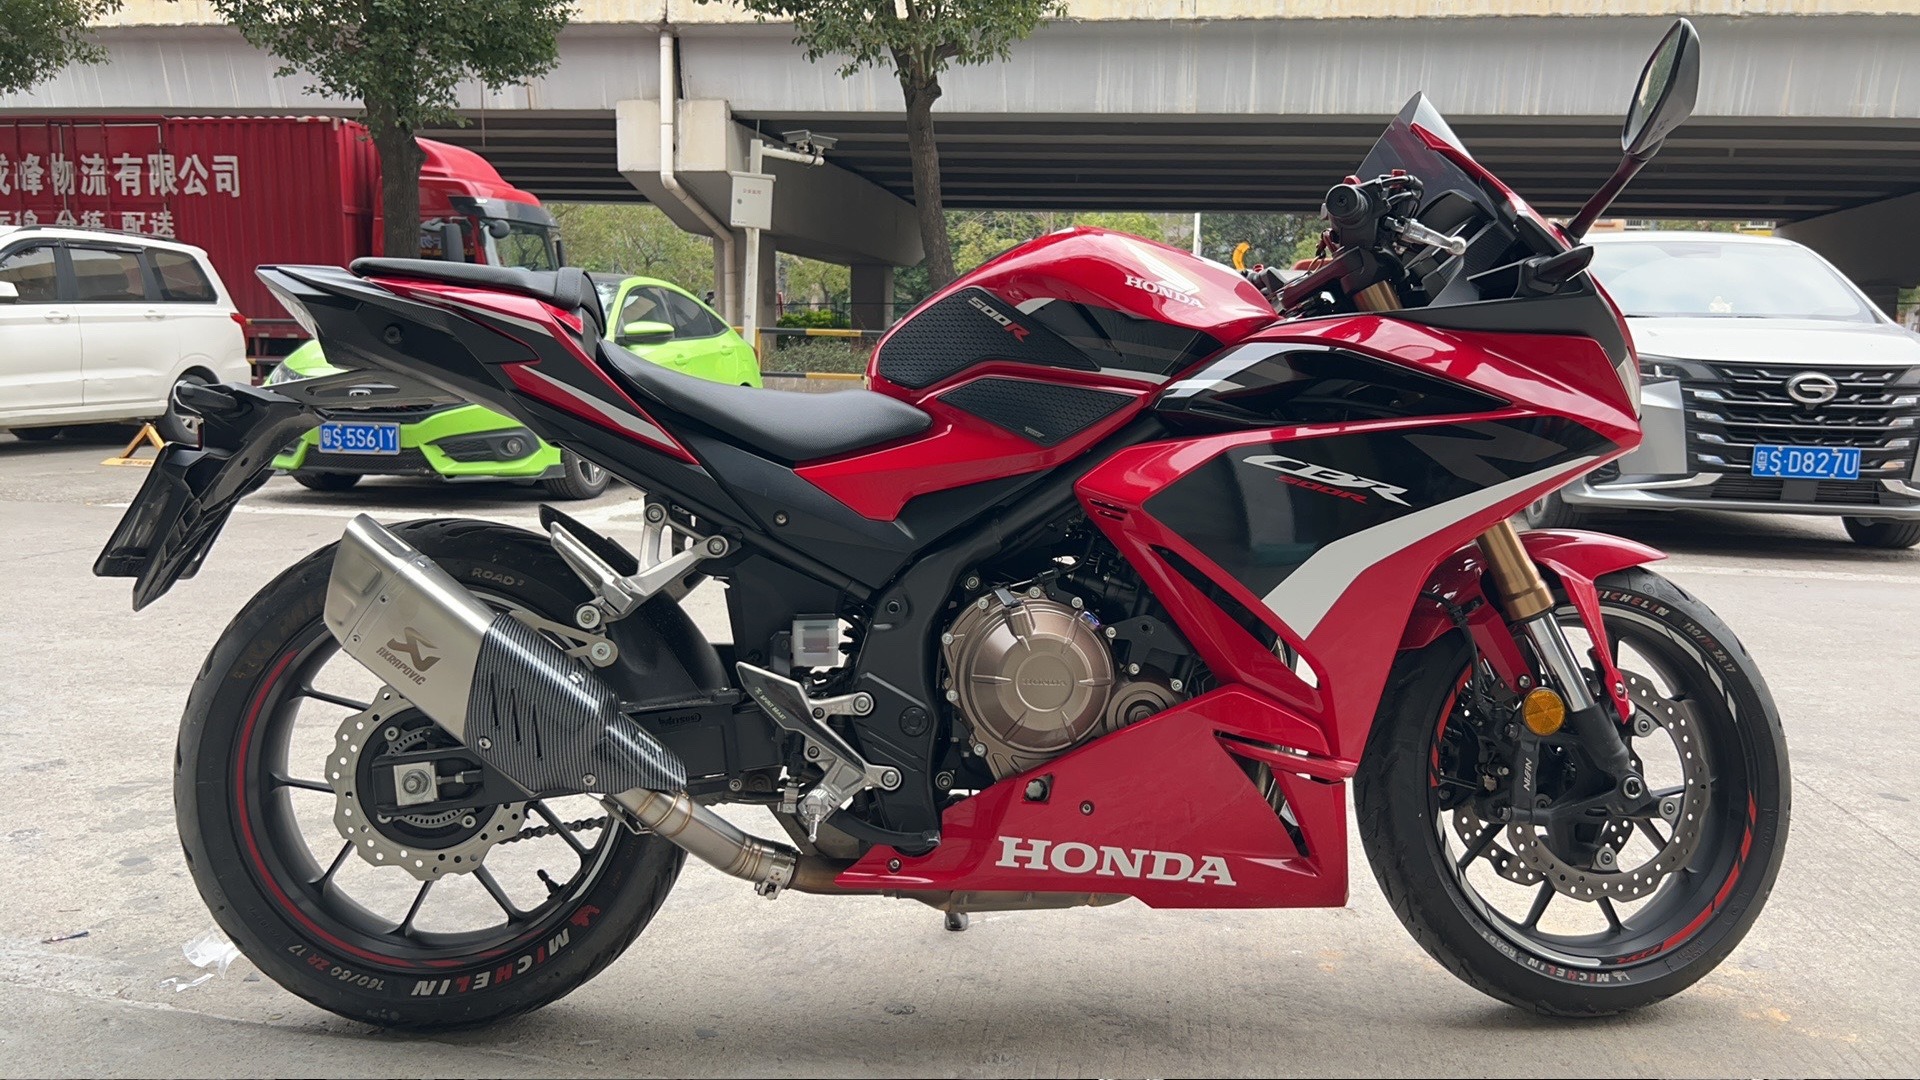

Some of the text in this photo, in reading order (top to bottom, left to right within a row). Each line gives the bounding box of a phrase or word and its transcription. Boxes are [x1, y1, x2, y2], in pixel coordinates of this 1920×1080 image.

[1124, 274, 1206, 310] HONDA
[968, 296, 1030, 343] 500R
[1243, 455, 1412, 507] CBR
[1273, 474, 1368, 505] 500R
[471, 567, 515, 586] ROAD
[376, 647, 427, 685] AKRAPOVIC
[995, 836, 1237, 886] HONDA
[288, 944, 307, 957] 17
[411, 928, 570, 996] MICHELIN
[1489, 934, 1517, 958] ROAD
[330, 966, 385, 991] 160/60
[1528, 957, 1610, 983] MICHELIN
